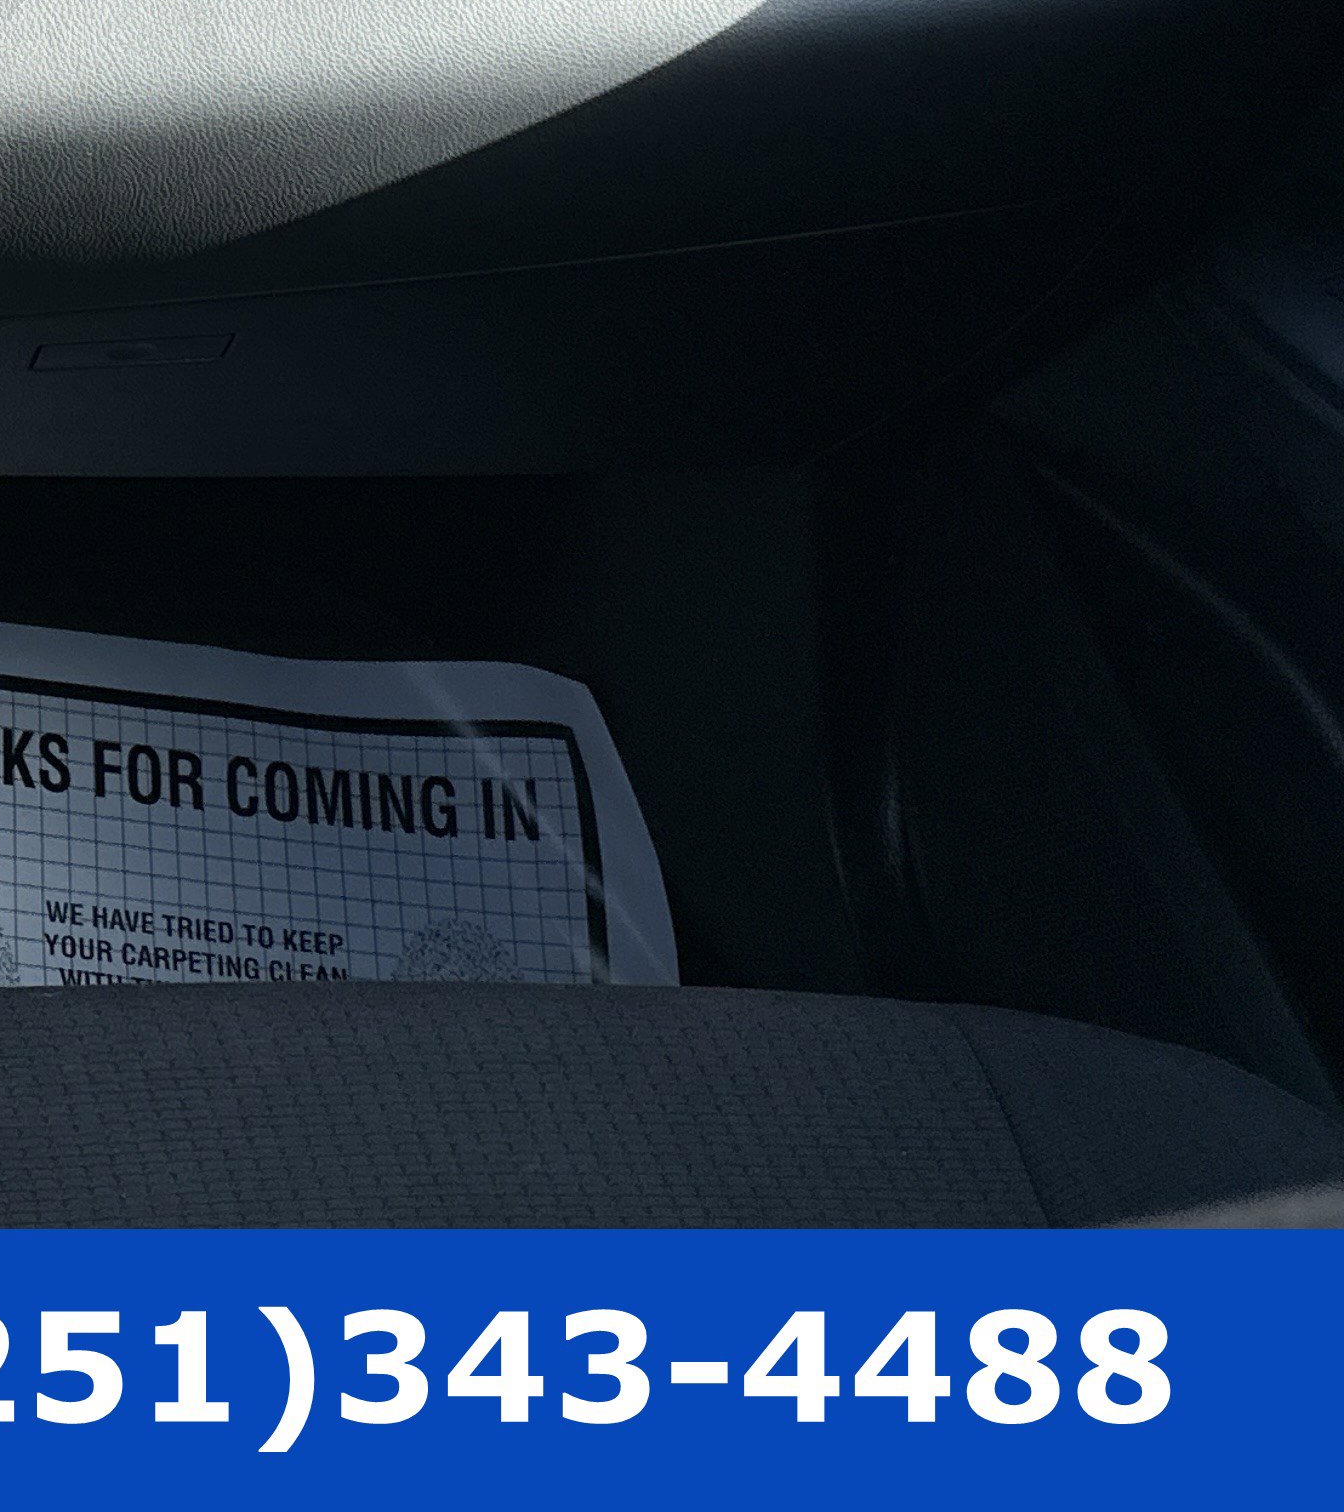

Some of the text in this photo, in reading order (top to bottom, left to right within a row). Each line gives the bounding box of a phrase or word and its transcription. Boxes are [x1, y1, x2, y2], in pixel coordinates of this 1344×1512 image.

[93, 739, 205, 811] FOR
[226, 754, 459, 838] COMING
[480, 776, 541, 841] IN
[45, 899, 344, 956] WE HAVE TRIED TO KEEP
[43, 933, 113, 963] YOUR
[121, 943, 260, 980] CARPETING
